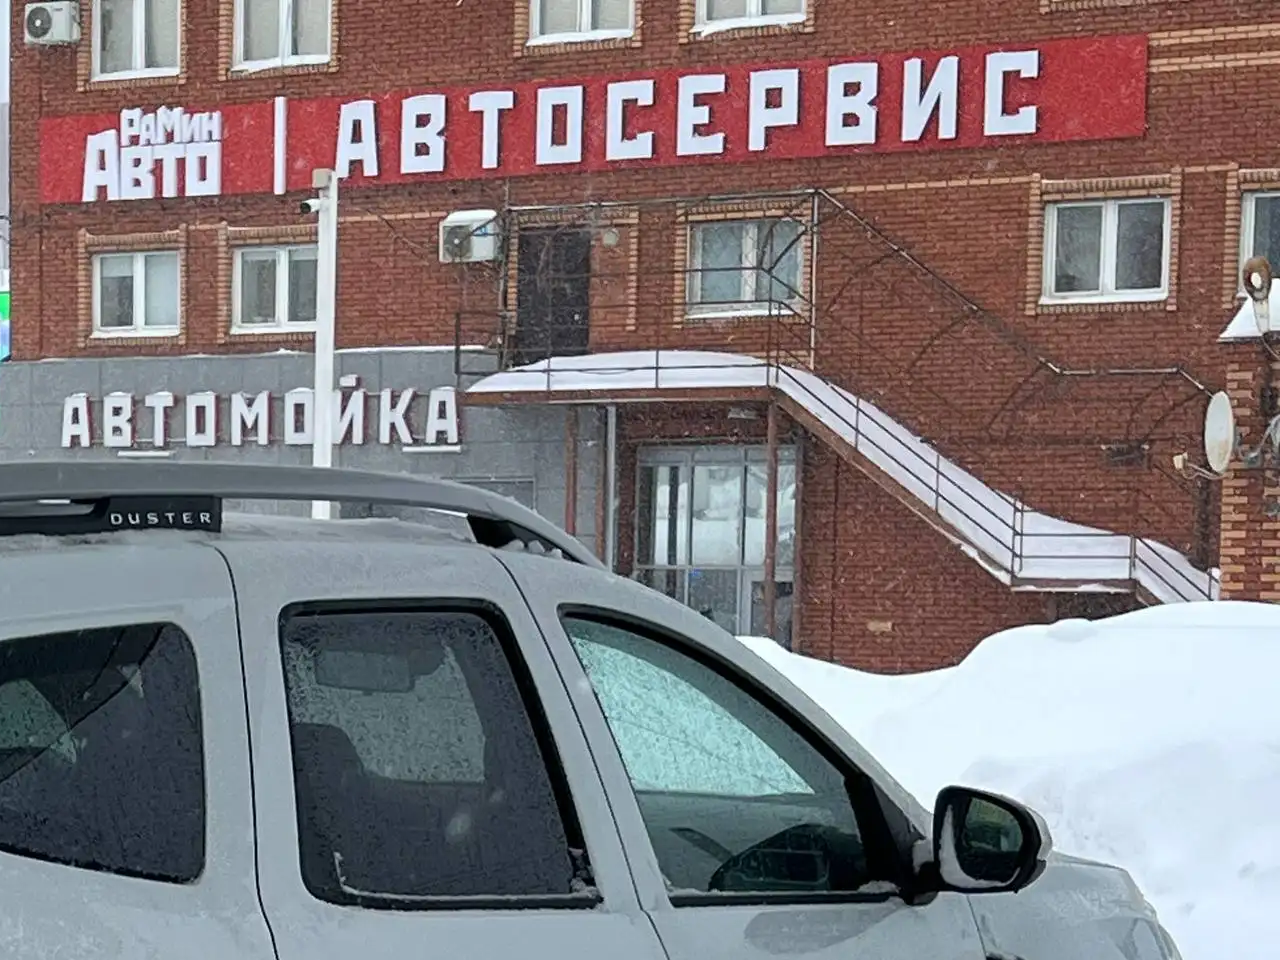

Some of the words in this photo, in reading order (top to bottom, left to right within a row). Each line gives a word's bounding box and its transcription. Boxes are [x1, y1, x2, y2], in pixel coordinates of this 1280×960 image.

[334, 49, 1040, 178] АВТОСЕРВИС
[60, 373, 461, 449] АВТОМОЙКА
[109, 511, 212, 526] DUSTER
